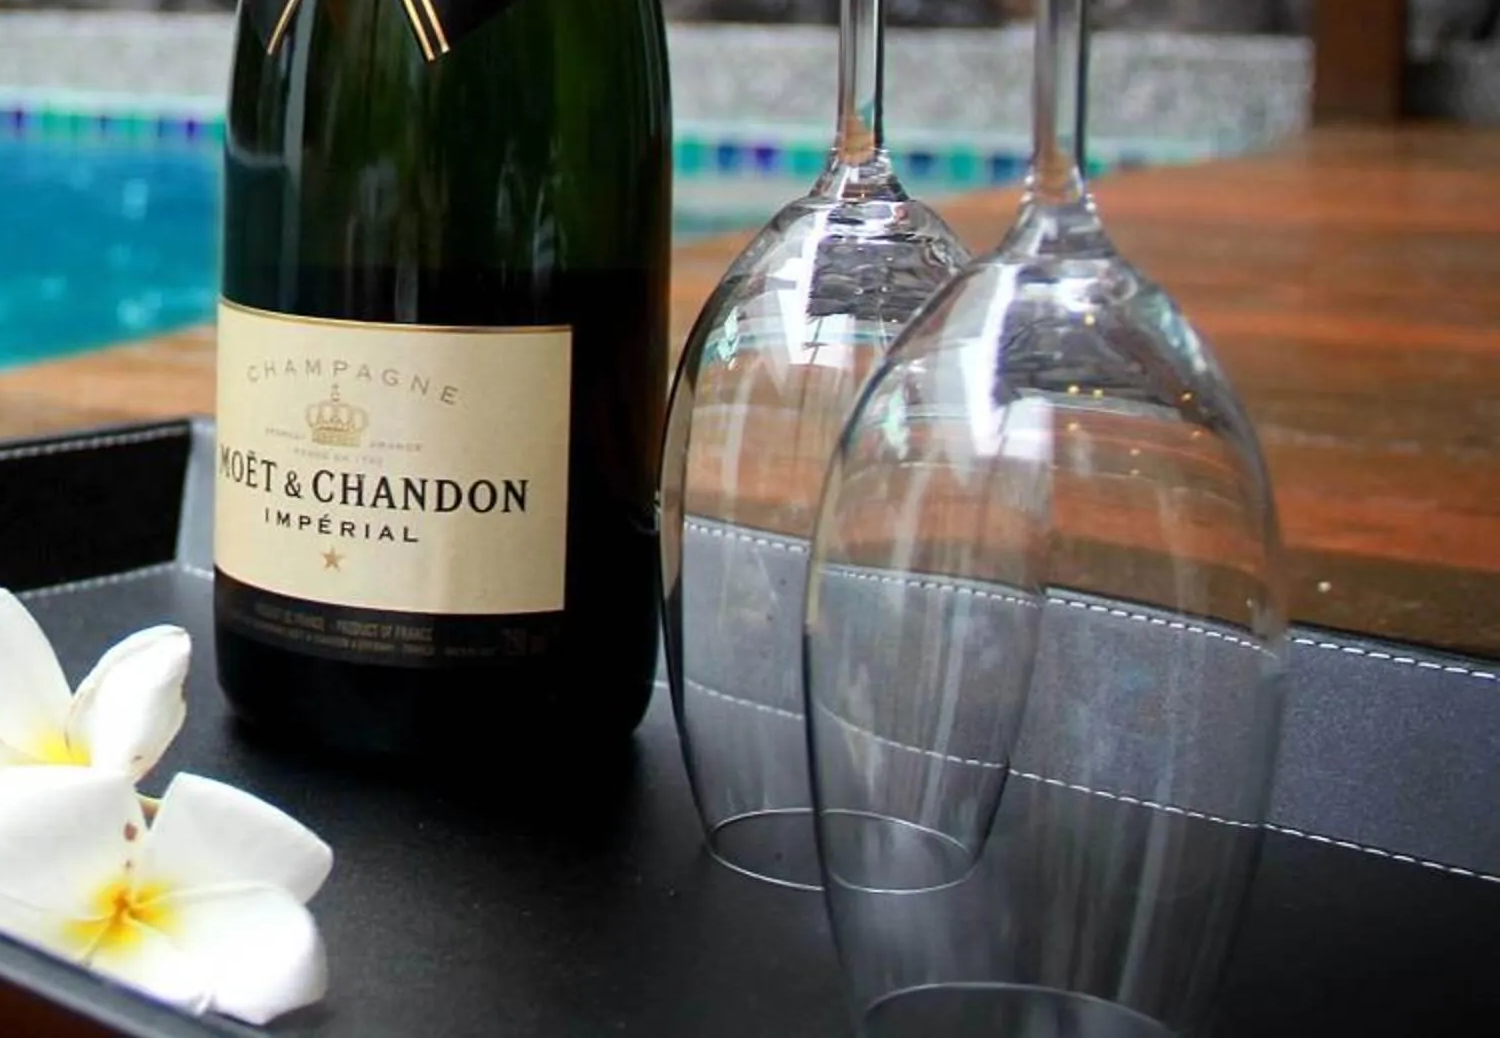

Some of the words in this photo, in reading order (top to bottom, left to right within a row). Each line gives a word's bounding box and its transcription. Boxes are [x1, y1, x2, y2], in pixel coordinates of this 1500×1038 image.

[246, 359, 461, 406] CHAMPAGNE
[283, 470, 304, 498] &
[311, 468, 530, 514] CHANDON
[264, 507, 419, 543] IMPÉRIAL
